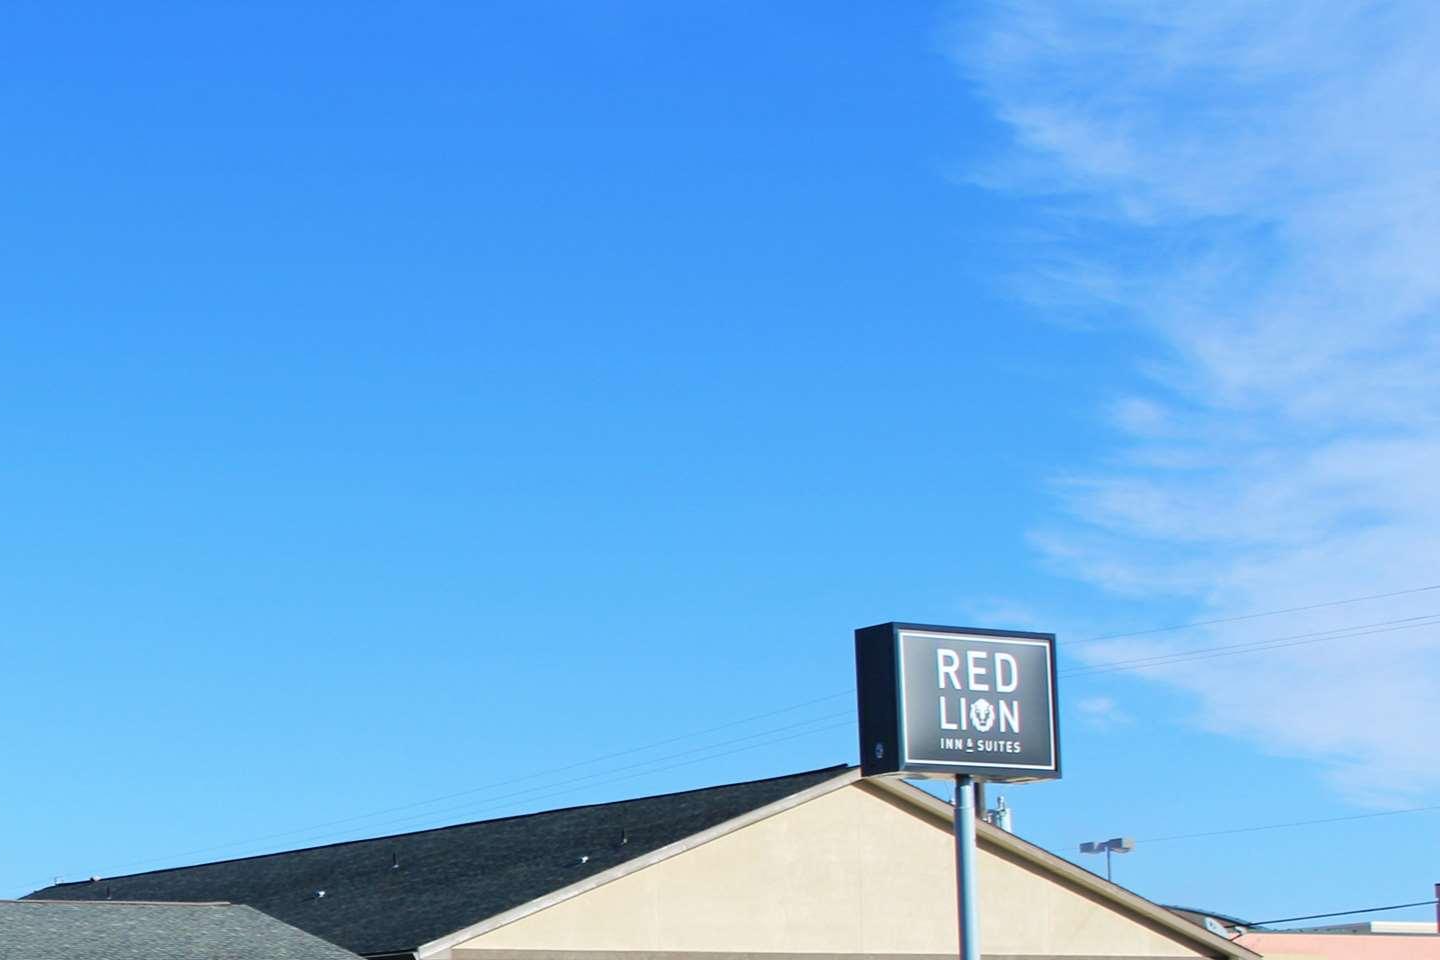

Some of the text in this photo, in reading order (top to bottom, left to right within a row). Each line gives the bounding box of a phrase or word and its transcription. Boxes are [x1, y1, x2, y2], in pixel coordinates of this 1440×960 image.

[936, 647, 1019, 693] RED
[939, 695, 1021, 733] LION
[940, 737, 963, 750] INN
[977, 739, 1021, 754] SUITES
